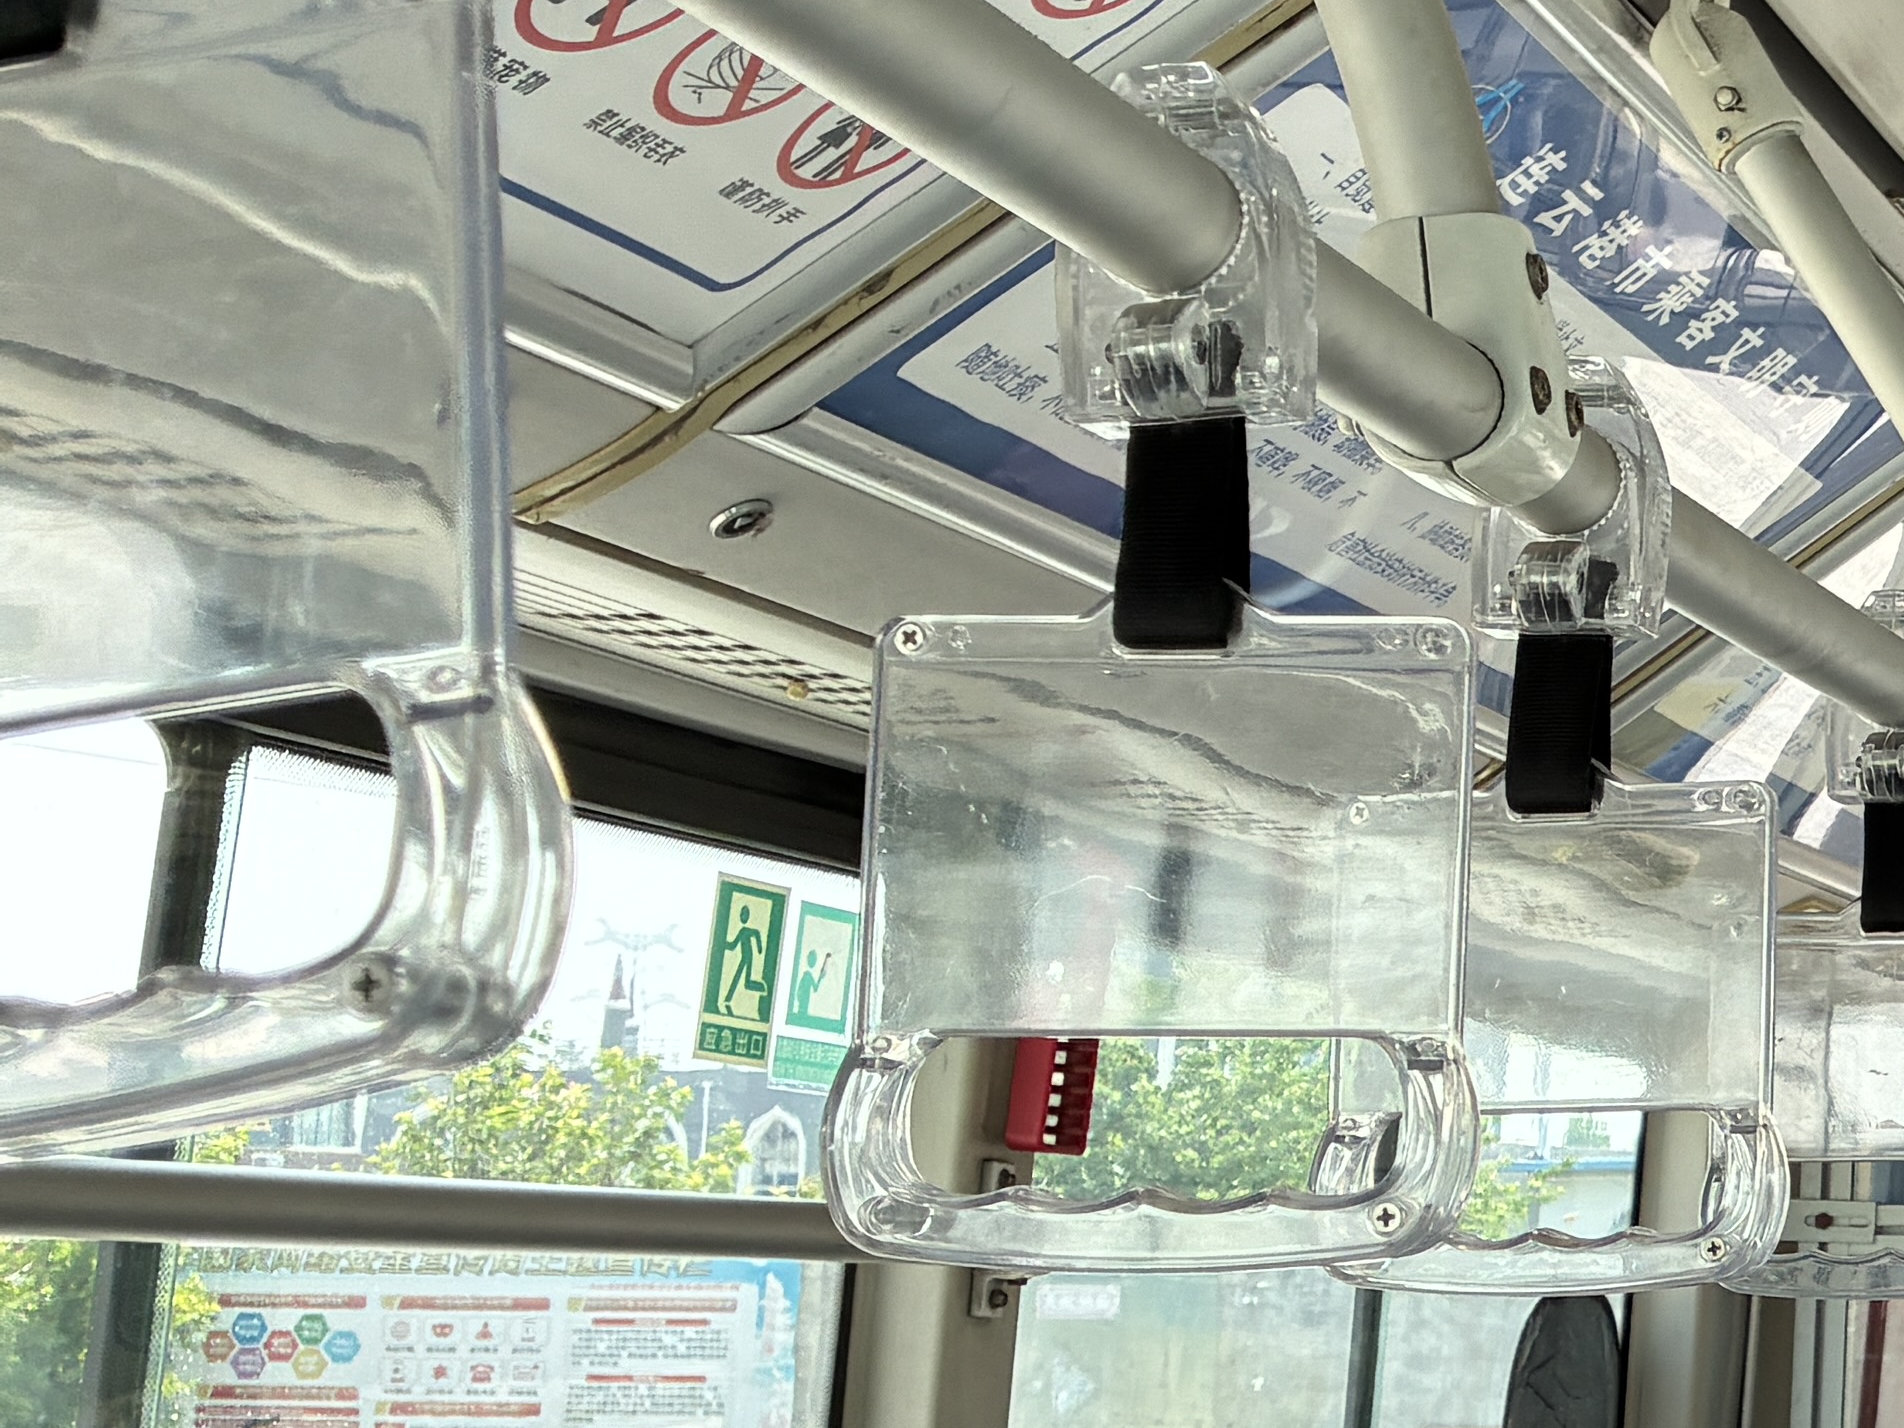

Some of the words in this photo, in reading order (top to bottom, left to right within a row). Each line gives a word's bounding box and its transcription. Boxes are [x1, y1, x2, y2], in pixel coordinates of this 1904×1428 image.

[583, 108, 687, 167] 禁止编织毛衣
[718, 177, 808, 225] 谨防扒手
